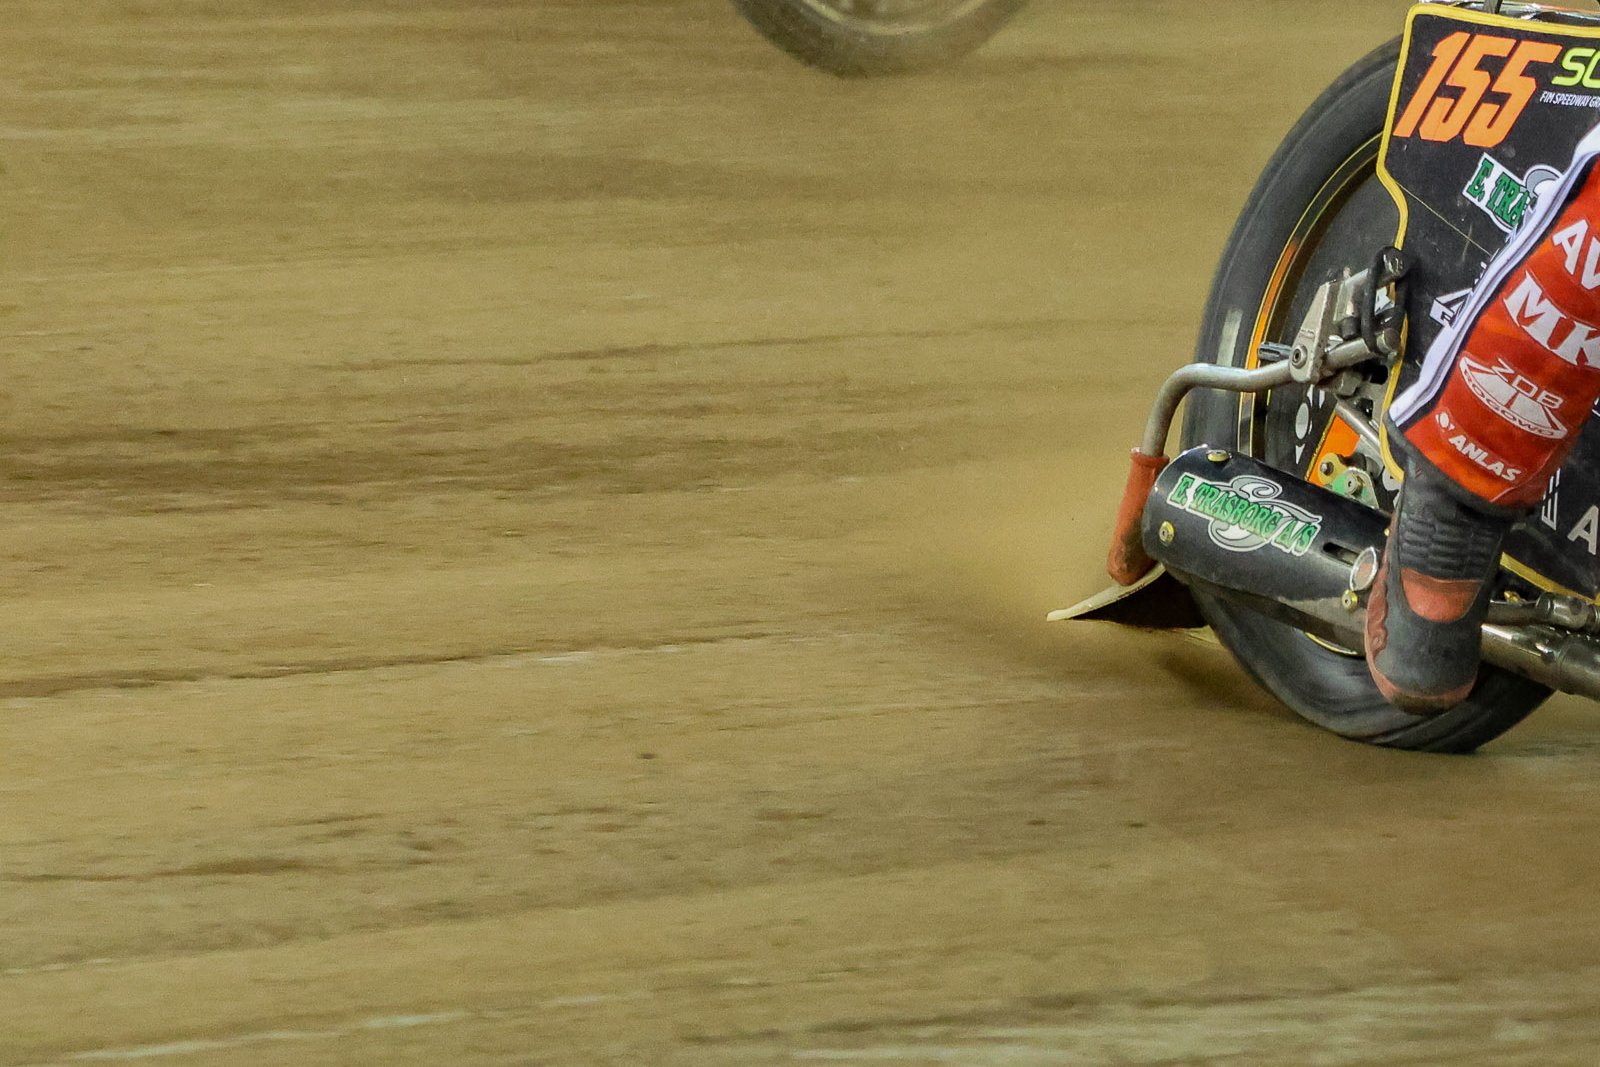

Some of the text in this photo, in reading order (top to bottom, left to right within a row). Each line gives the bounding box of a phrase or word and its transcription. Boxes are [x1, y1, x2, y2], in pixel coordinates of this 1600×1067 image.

[1391, 31, 1564, 148] 155
[1540, 91, 1555, 103] FIM
[1553, 93, 1591, 107] SPEEDWAY
[1491, 356, 1565, 411] ZDB
[1449, 434, 1522, 483] ANLAS
[1188, 482, 1285, 541] TRASBORG
[1279, 520, 1318, 554] A/S
